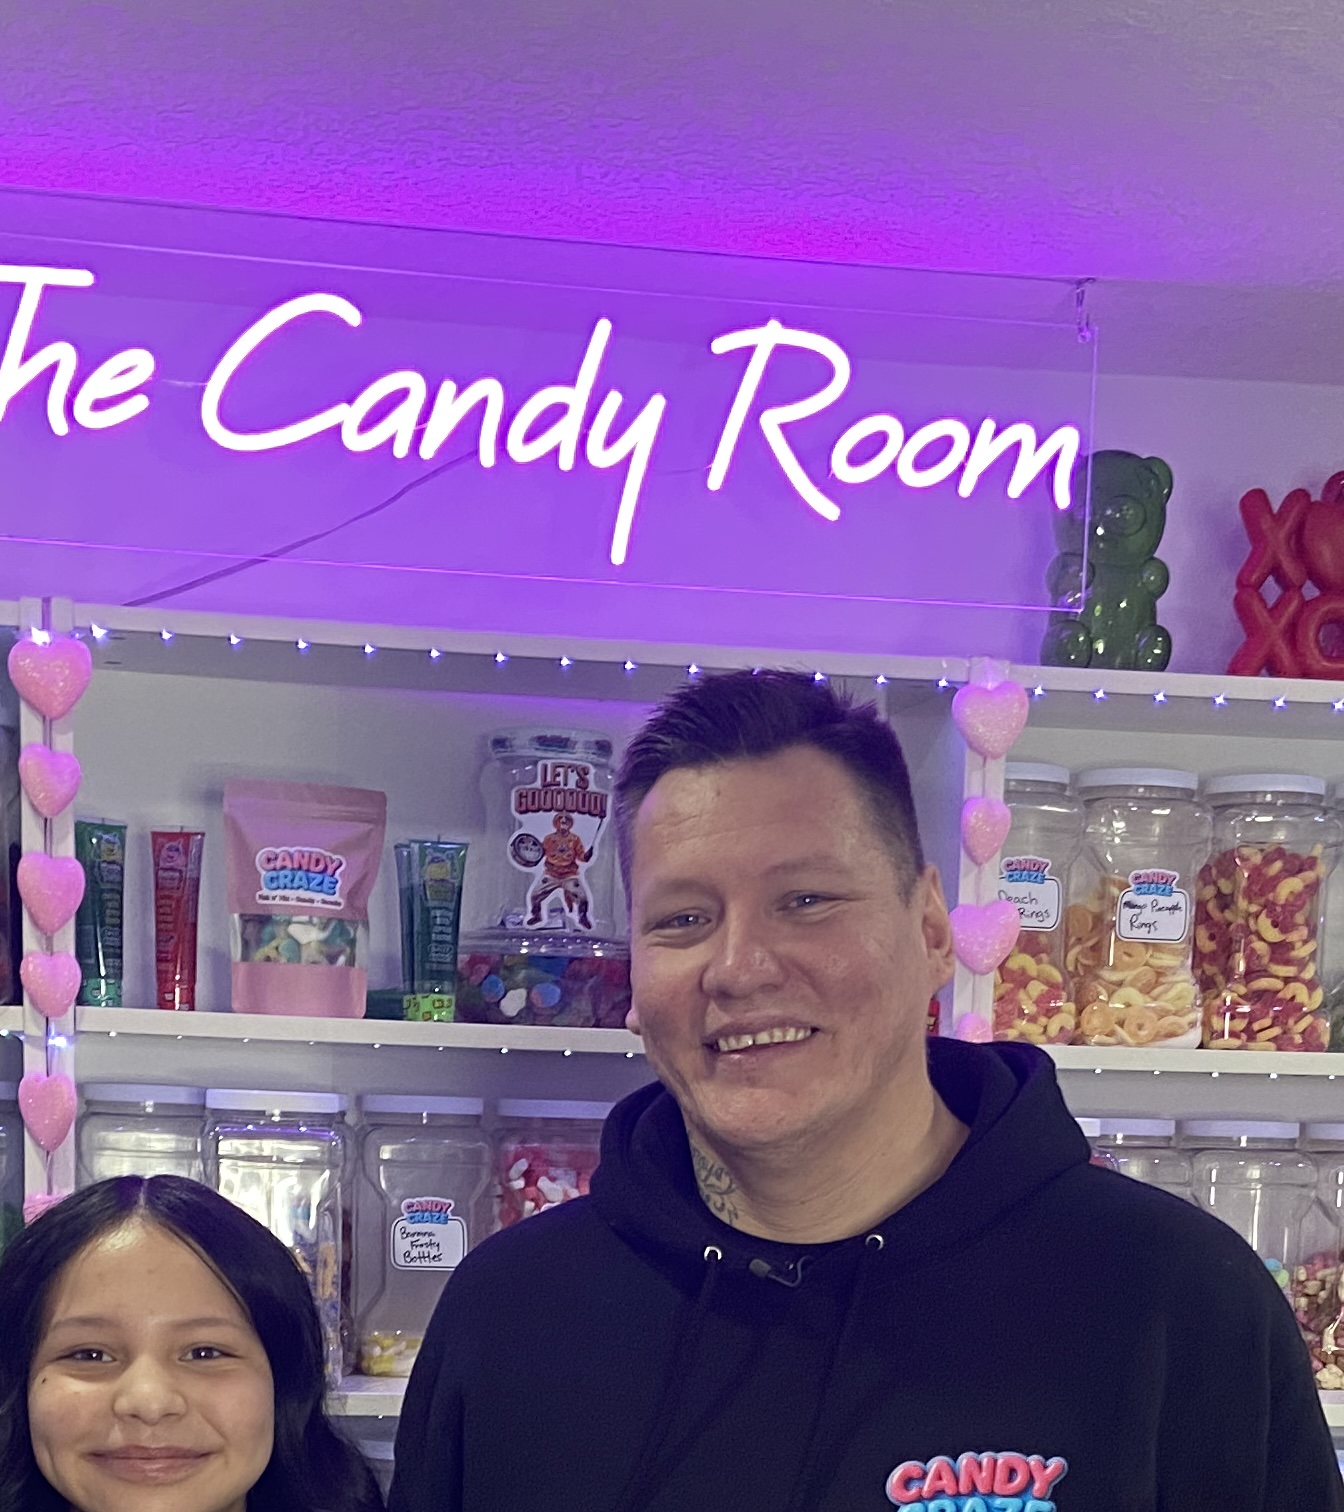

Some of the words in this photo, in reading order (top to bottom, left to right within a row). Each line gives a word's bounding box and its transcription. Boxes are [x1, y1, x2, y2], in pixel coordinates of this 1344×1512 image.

[199, 291, 669, 566] Candy
[707, 317, 1082, 523] Room
[541, 763, 590, 789] LET'S
[260, 850, 342, 877] CANDY
[264, 870, 338, 896] CRAZE
[403, 1250, 443, 1265] Bottles
[888, 1453, 1066, 1504] CANDY
